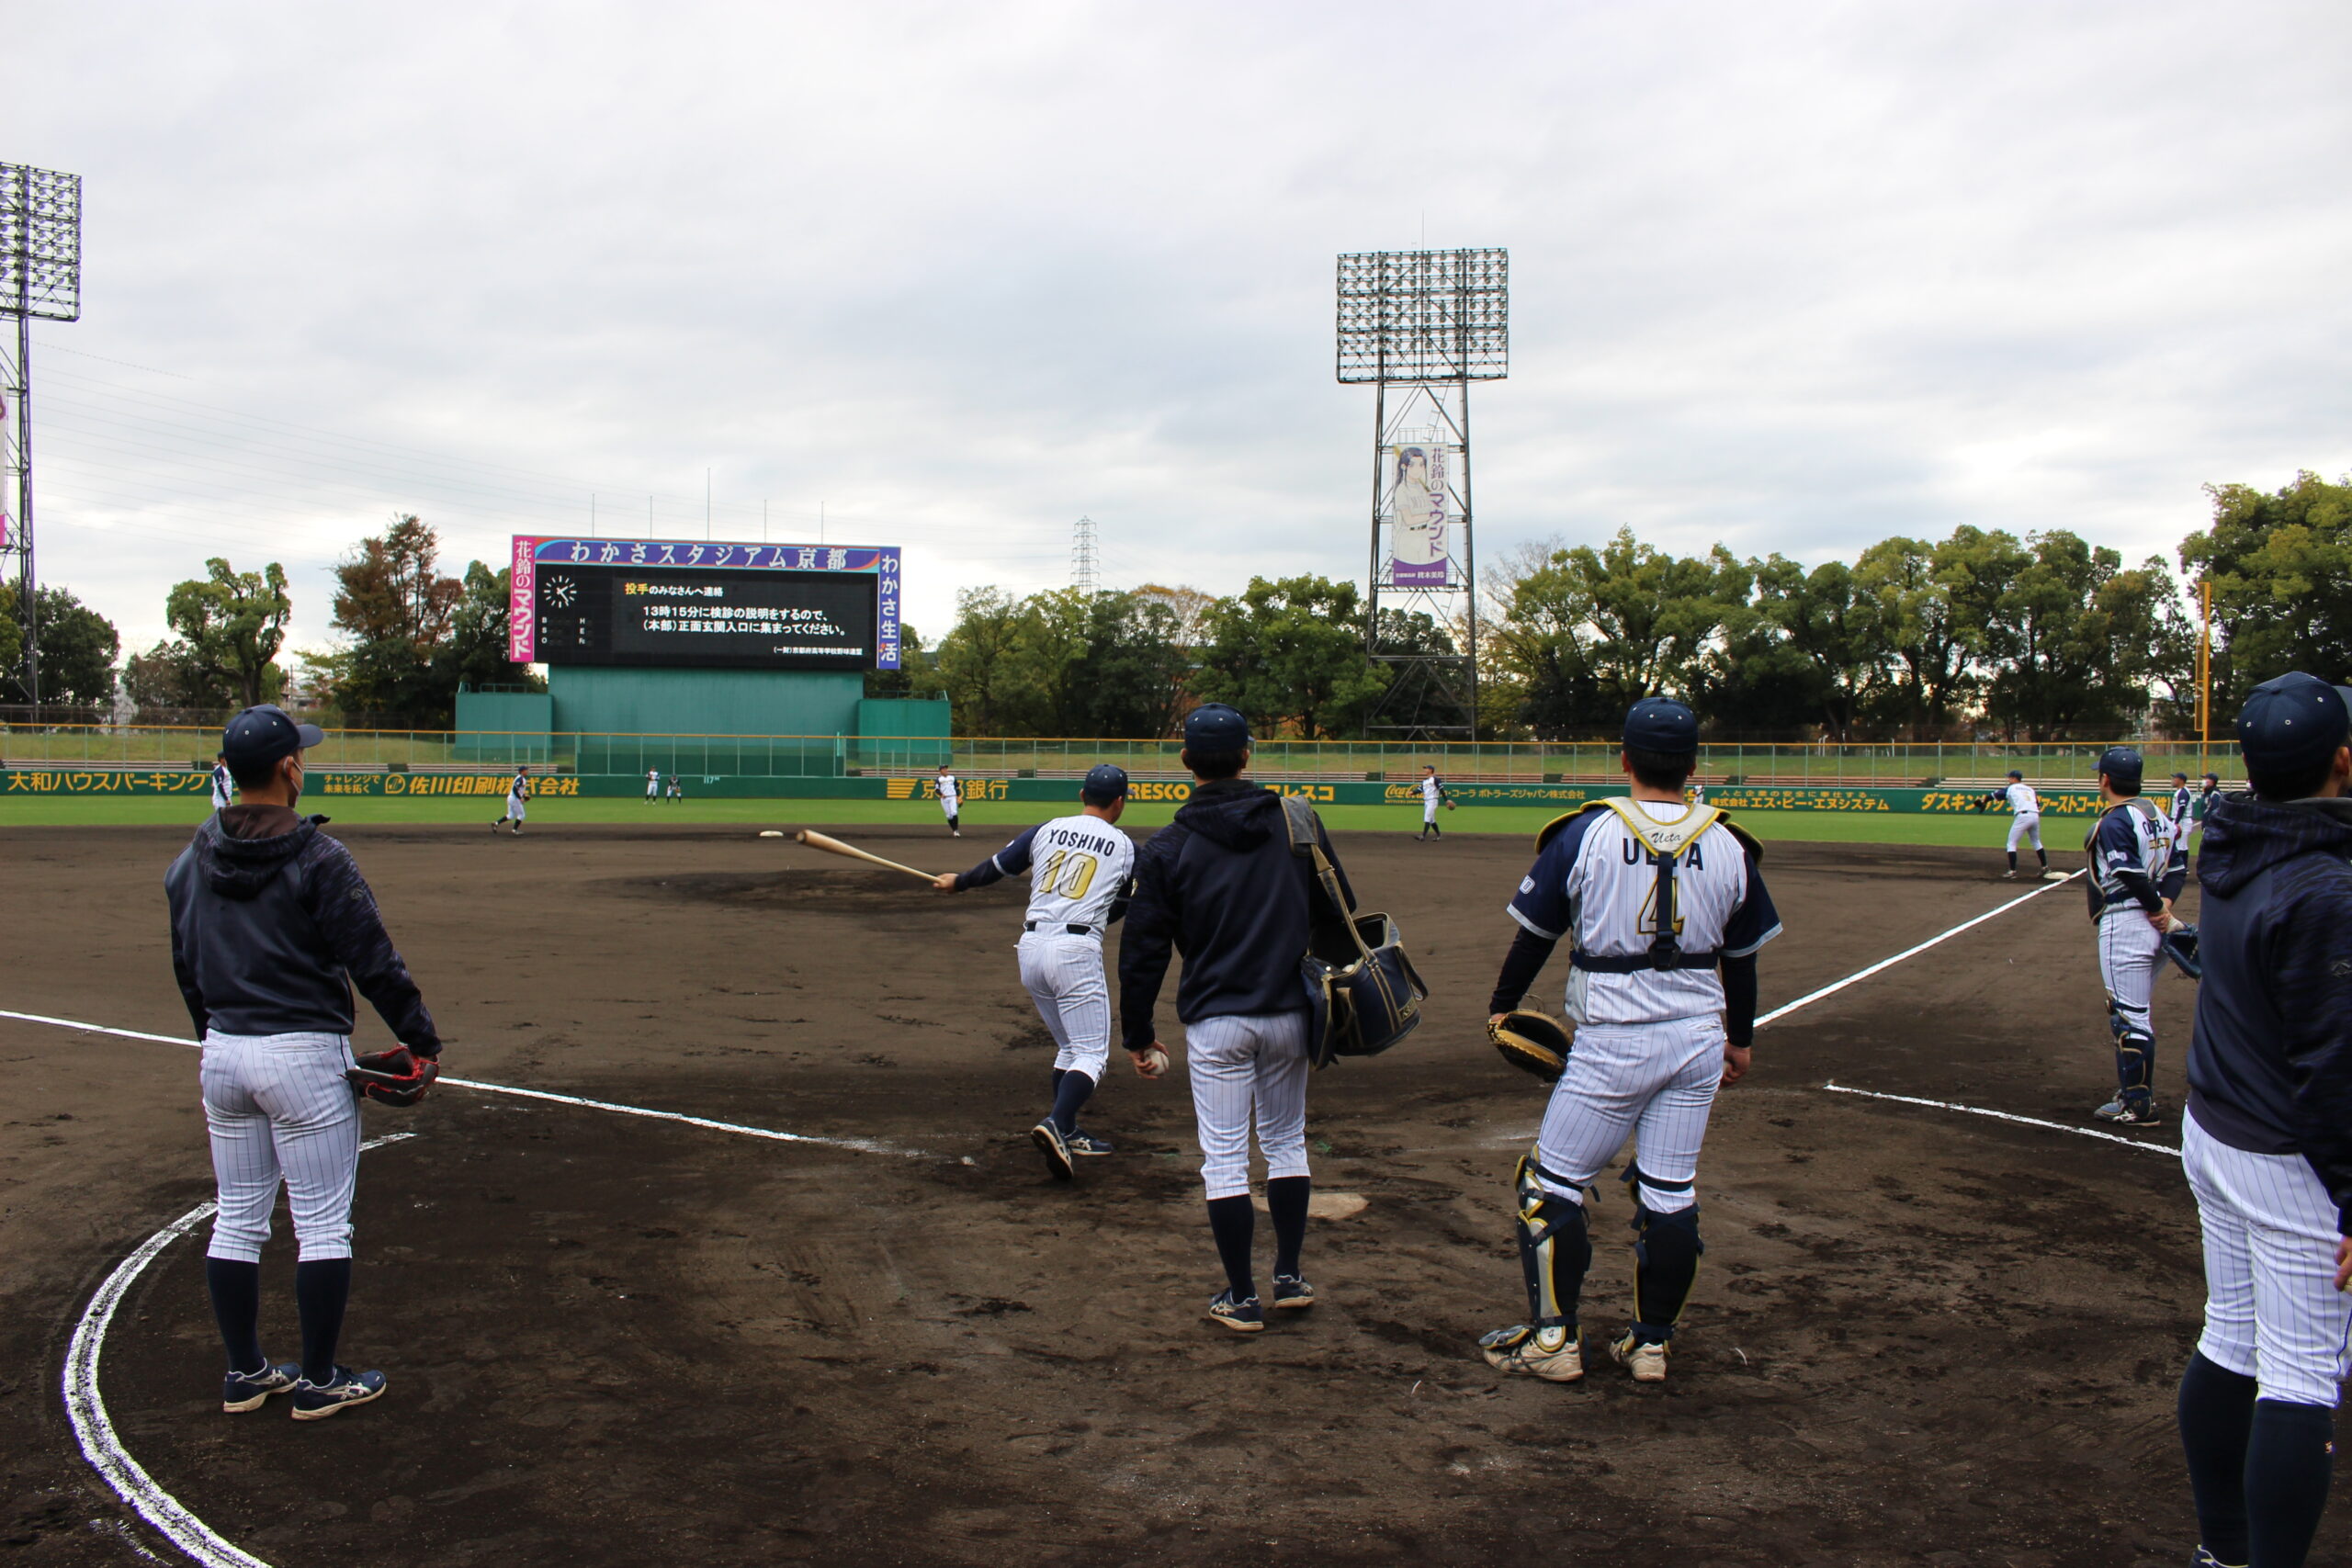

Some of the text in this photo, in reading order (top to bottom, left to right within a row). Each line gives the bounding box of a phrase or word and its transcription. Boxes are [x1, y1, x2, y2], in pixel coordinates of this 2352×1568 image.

[1430, 448, 1444, 557] 花鈴のマウンド
[571, 541, 847, 568] わかさスタジアム京都
[514, 540, 533, 658] 花鈴のマウンド
[625, 582, 724, 597] 投手のみなさんへ連絡
[881, 555, 899, 661] わかさ生活
[7, 772, 211, 792] 大和ハウスパーキング
[324, 774, 381, 784] チャレンジで
[409, 775, 580, 795] 佐川印刷株式会社
[1127, 783, 1192, 801] RESCO
[1710, 798, 1747, 807] 株式会社
[1048, 829, 1115, 857] YOSHINO
[1651, 832, 1682, 844] Ueta
[1623, 837, 1703, 871] UEA
[1038, 850, 1098, 900] 10
[1637, 874, 1685, 936] 4
